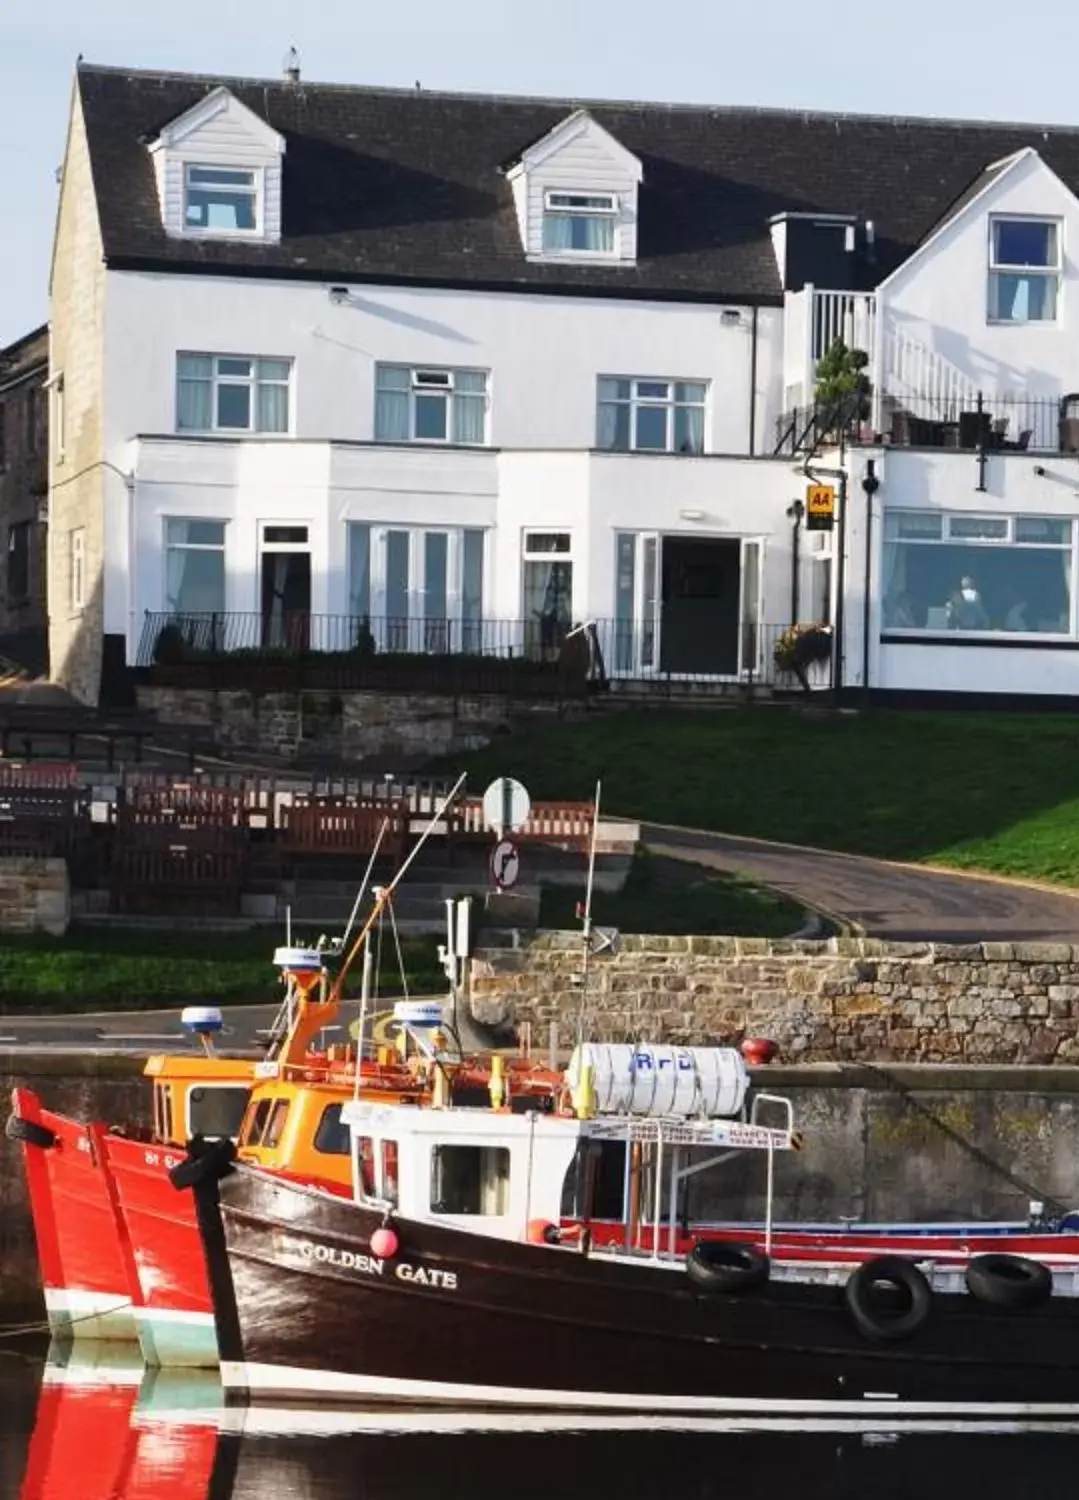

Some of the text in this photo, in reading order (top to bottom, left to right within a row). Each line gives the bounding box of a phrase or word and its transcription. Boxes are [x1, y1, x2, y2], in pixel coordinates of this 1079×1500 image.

[812, 492, 830, 506] AA
[299, 1241, 458, 1289] GOLDEN GATE
